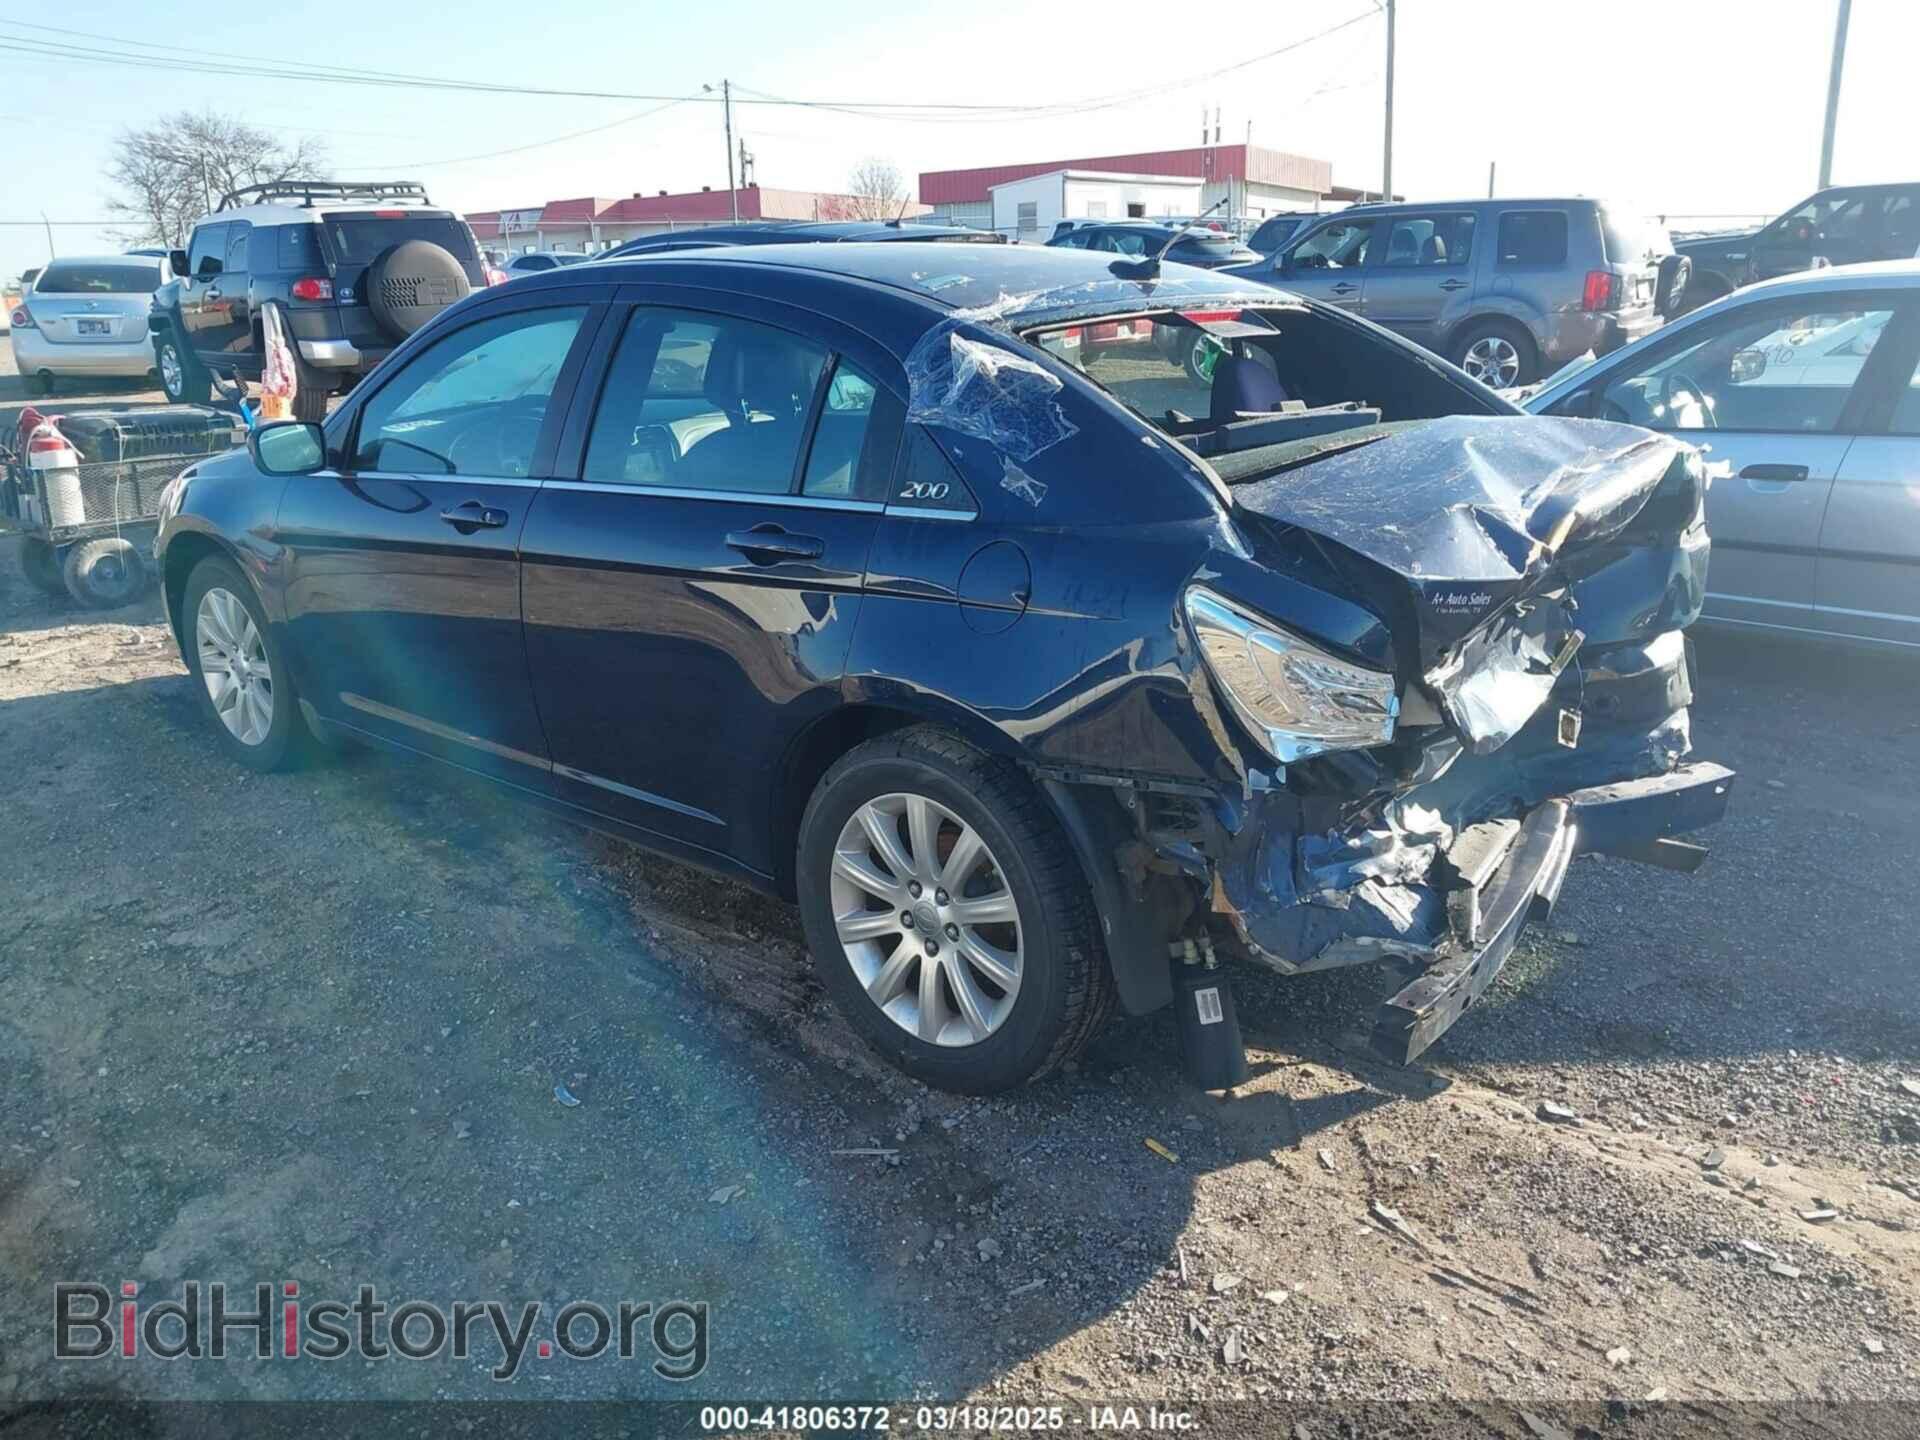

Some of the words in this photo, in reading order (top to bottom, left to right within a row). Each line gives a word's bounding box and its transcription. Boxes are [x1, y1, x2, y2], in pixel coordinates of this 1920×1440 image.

[900, 481, 949, 499] 200
[1431, 592, 1443, 605] A+
[1446, 592, 1468, 605] Auto
[1468, 592, 1492, 605] Sales
